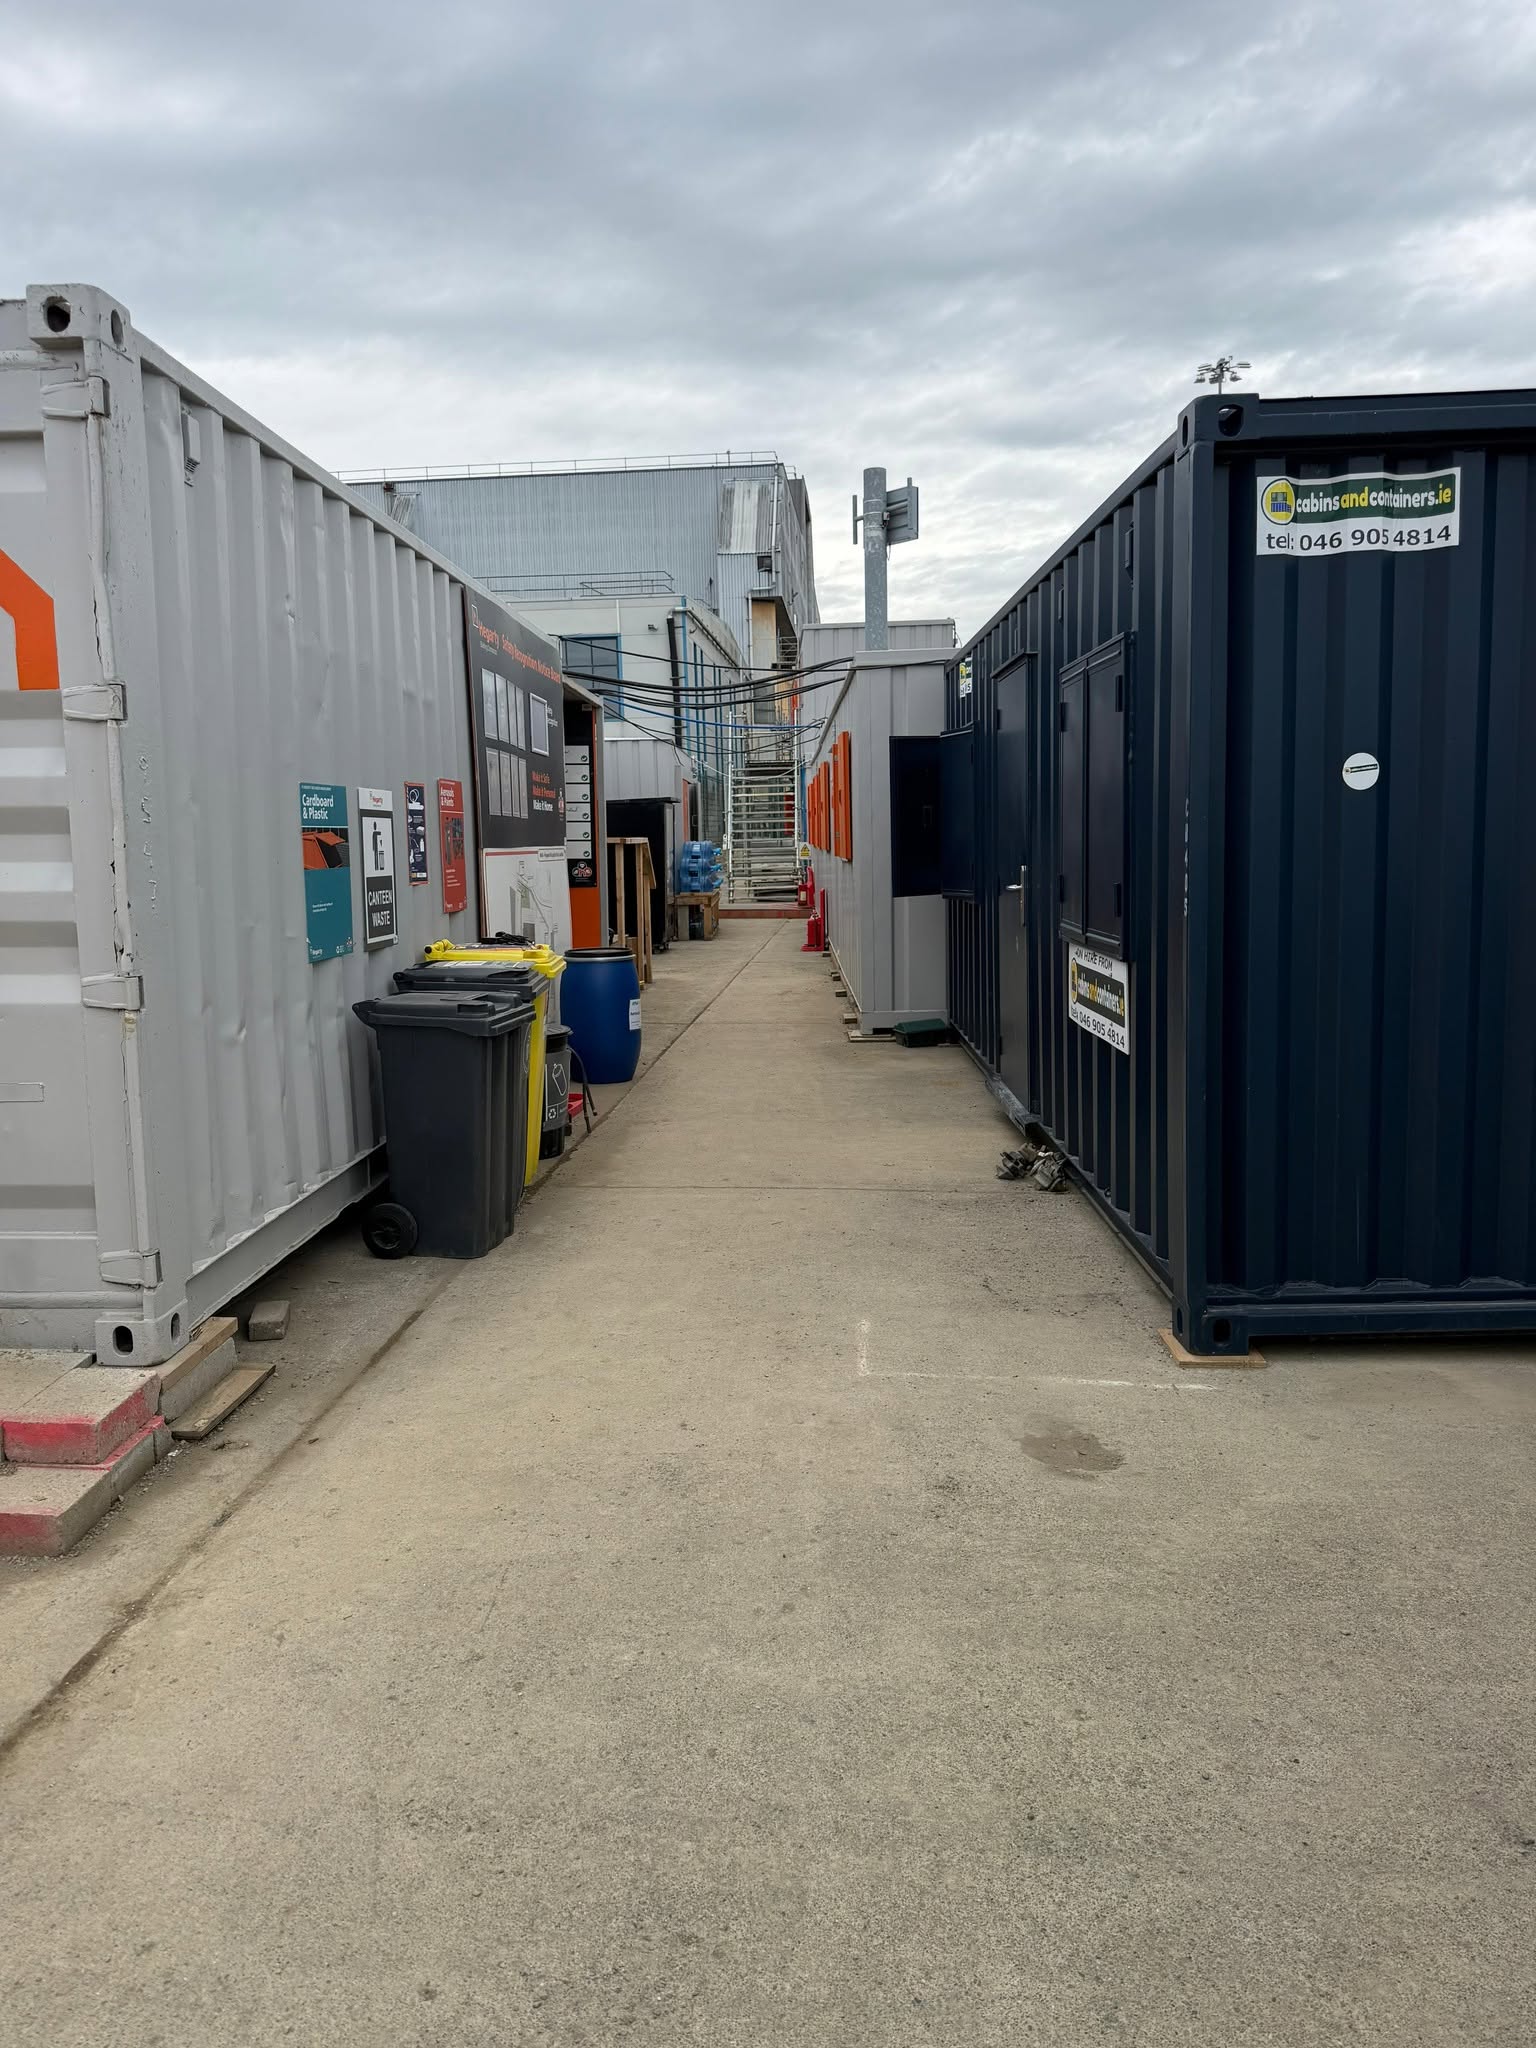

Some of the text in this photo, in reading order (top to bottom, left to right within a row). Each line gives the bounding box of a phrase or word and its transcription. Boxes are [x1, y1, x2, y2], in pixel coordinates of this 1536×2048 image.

[1296, 484, 1452, 513] cabinsandcontainers.ie
[1266, 525, 1451, 551] tel: 046 905 4814
[302, 794, 333, 808] Cardboard
[303, 807, 328, 820] & Plastic
[368, 889, 392, 906] CANTEEN
[372, 910, 390, 927] WASTE
[1083, 951, 1098, 965] HIRE
[1098, 956, 1113, 971] FROM
[1079, 1011, 1091, 1028] 046
[1092, 1018, 1106, 1037] 905
[1107, 1027, 1125, 1049] 4814
